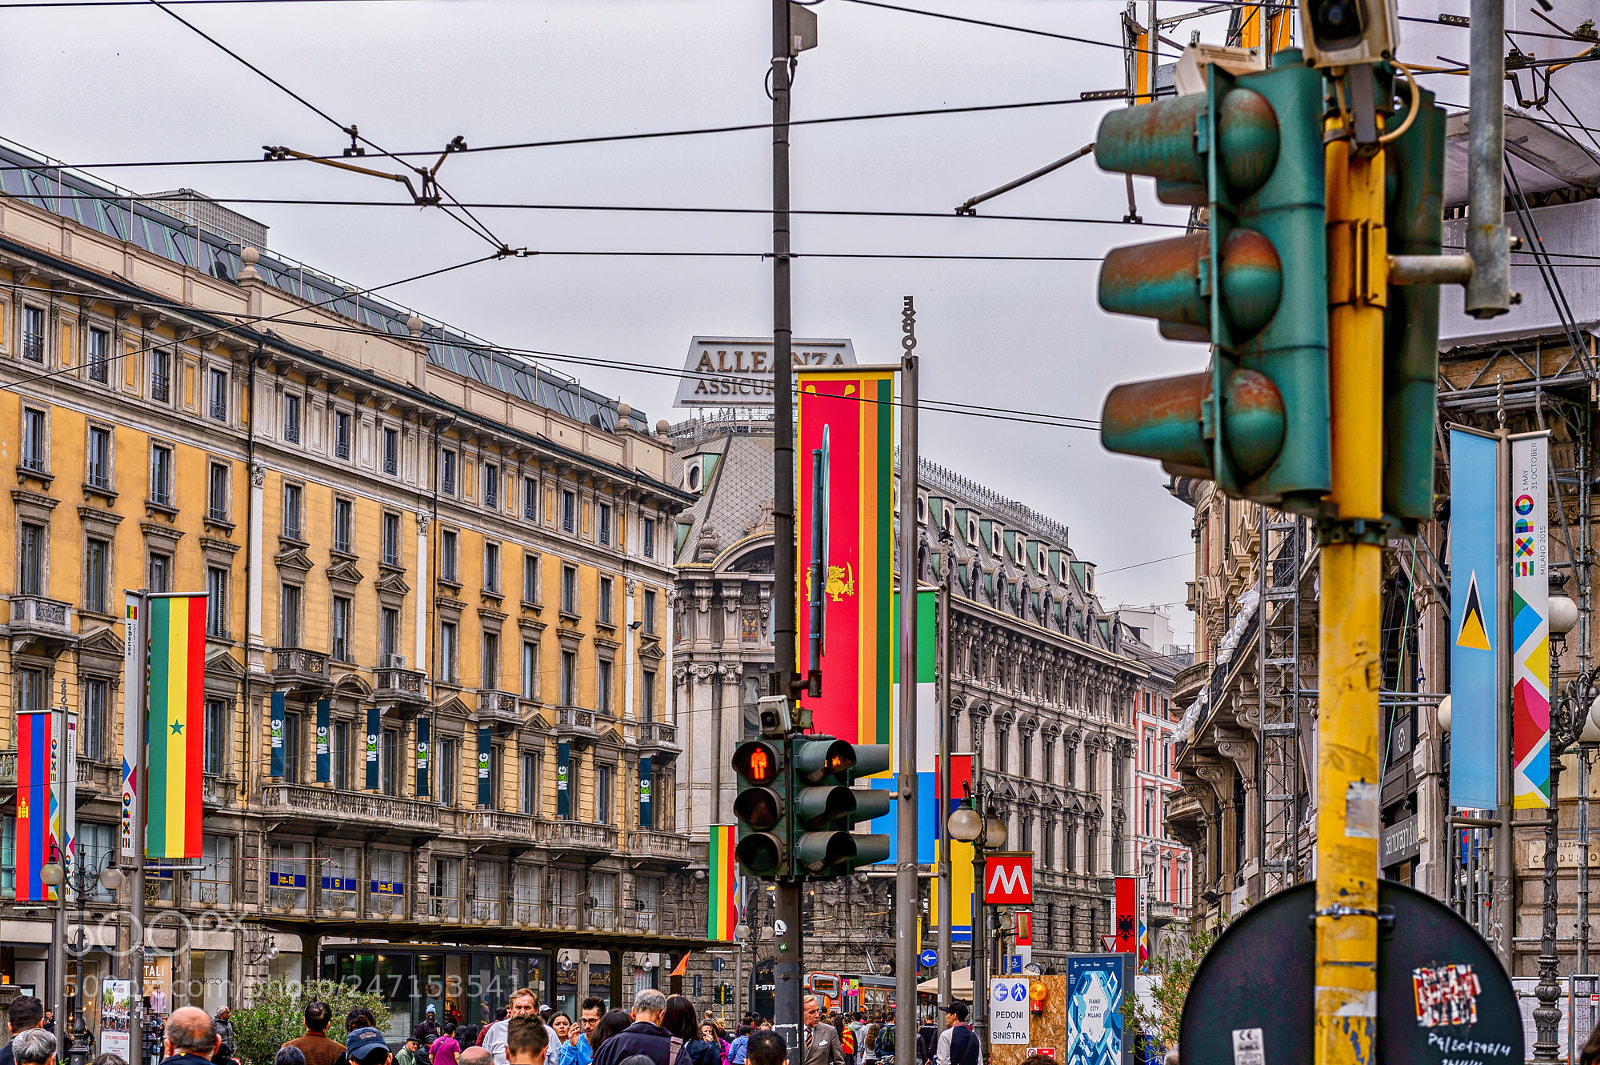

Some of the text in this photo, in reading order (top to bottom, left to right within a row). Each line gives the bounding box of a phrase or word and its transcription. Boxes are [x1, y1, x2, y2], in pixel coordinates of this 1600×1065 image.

[694, 377, 775, 396] ASSICUR
[1530, 442, 1538, 490] 31 OCTOBER
[1514, 494, 1534, 577] EXPO
[122, 792, 131, 849] EXPO
[1532, 853, 1598, 863] CDUO
[987, 865, 1029, 894] M
[995, 1011, 1024, 1019] PEDONI
[992, 1031, 1027, 1040] SINISTRA
[1006, 1022, 1013, 1030] A
